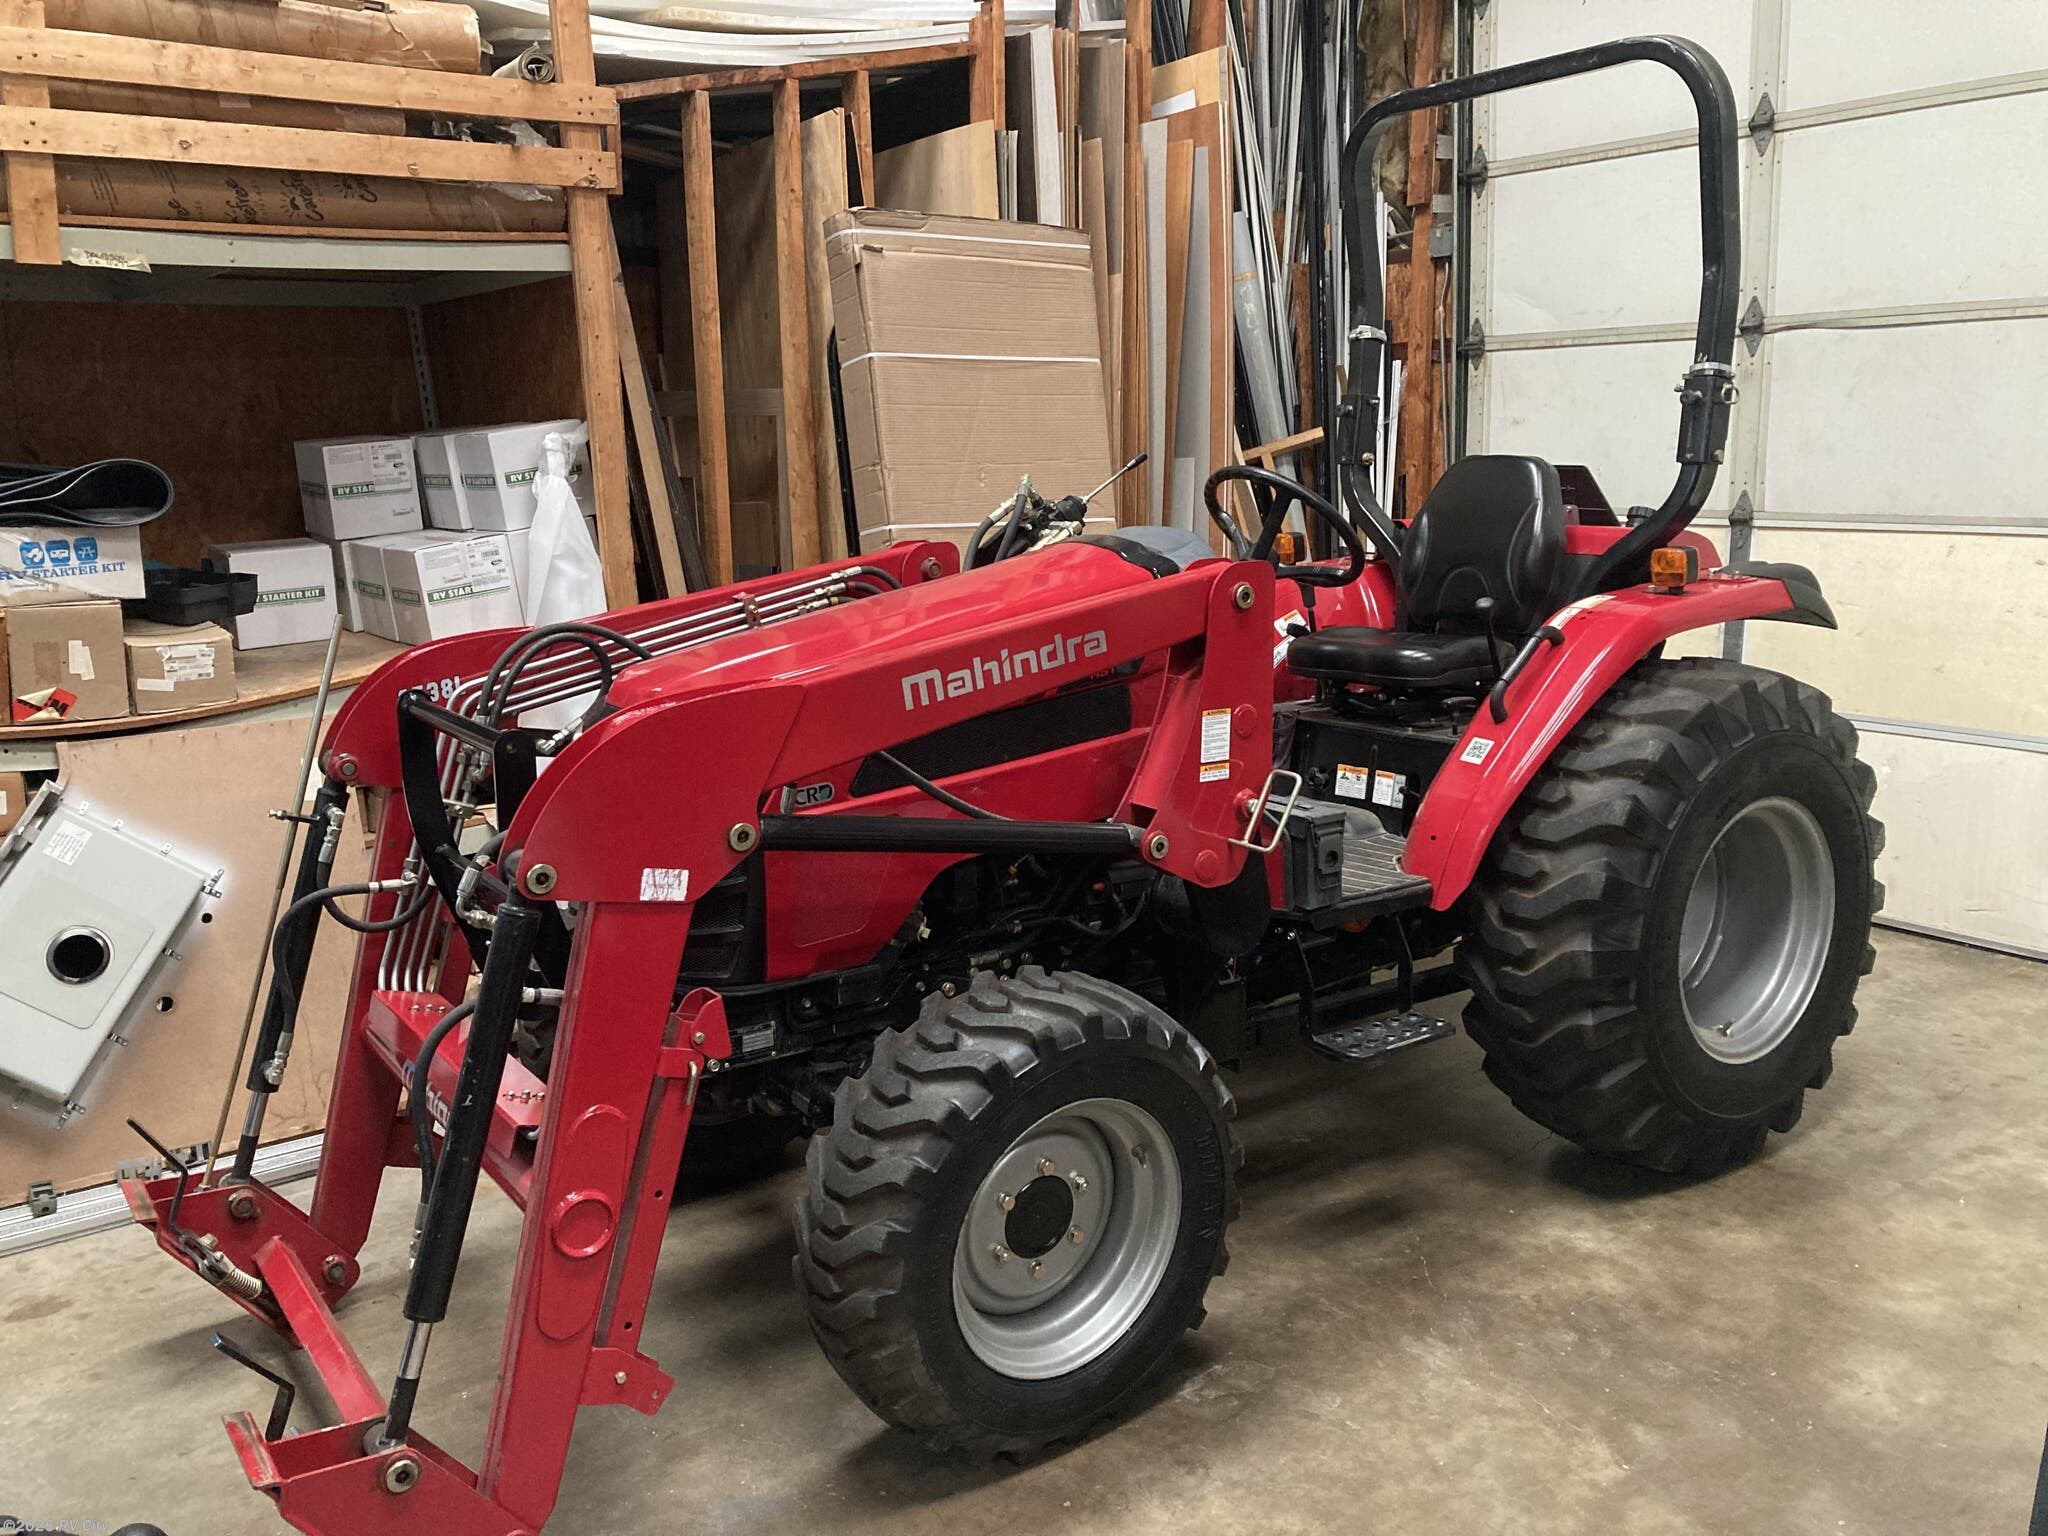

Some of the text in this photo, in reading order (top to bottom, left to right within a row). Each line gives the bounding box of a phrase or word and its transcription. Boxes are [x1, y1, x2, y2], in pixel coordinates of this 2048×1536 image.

[511, 475, 523, 483] RV
[338, 486, 351, 495] RV
[353, 484, 375, 494] STAR
[32, 564, 99, 579] STARTER
[102, 561, 126, 574] KIT
[262, 591, 303, 602] STARTER
[305, 589, 321, 598] KIT
[433, 591, 447, 601] RV
[449, 585, 476, 598] START
[901, 629, 1108, 711] Mahindra
